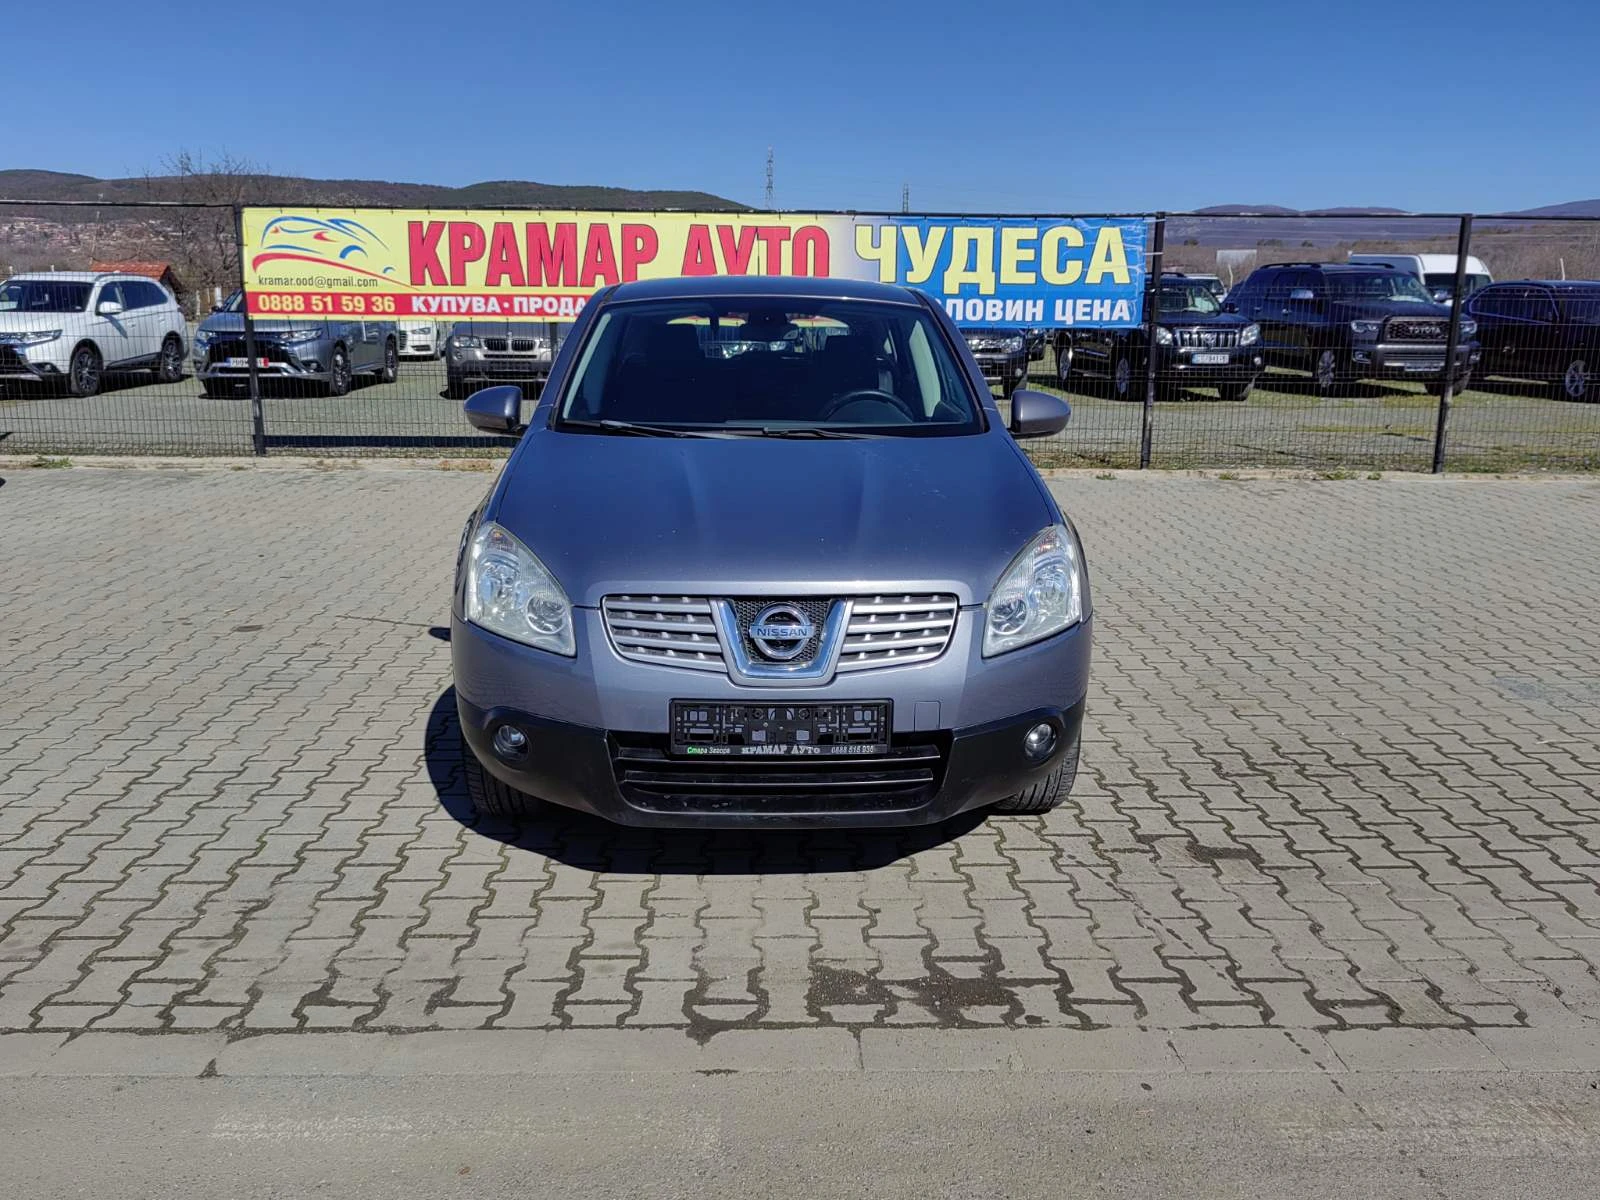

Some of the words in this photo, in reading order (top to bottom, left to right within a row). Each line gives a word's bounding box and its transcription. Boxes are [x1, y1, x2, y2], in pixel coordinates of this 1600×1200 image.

[407, 220, 659, 287] КРАМАР
[854, 223, 1131, 295] ЧУДЕСА
[258, 275, 378, 289] kramar.ood@gmail.com
[258, 294, 304, 311] 0888
[311, 295, 333, 312] 51
[341, 296, 365, 312] 59
[371, 296, 396, 313] 36
[412, 296, 502, 314] КУПУВА
[935, 298, 1044, 321] ЛОВИН
[1054, 298, 1131, 325] ЦЕНА
[1408, 326, 1441, 334] TOYOTA
[756, 628, 808, 637] NISSAN
[742, 744, 788, 755] КРАМАР
